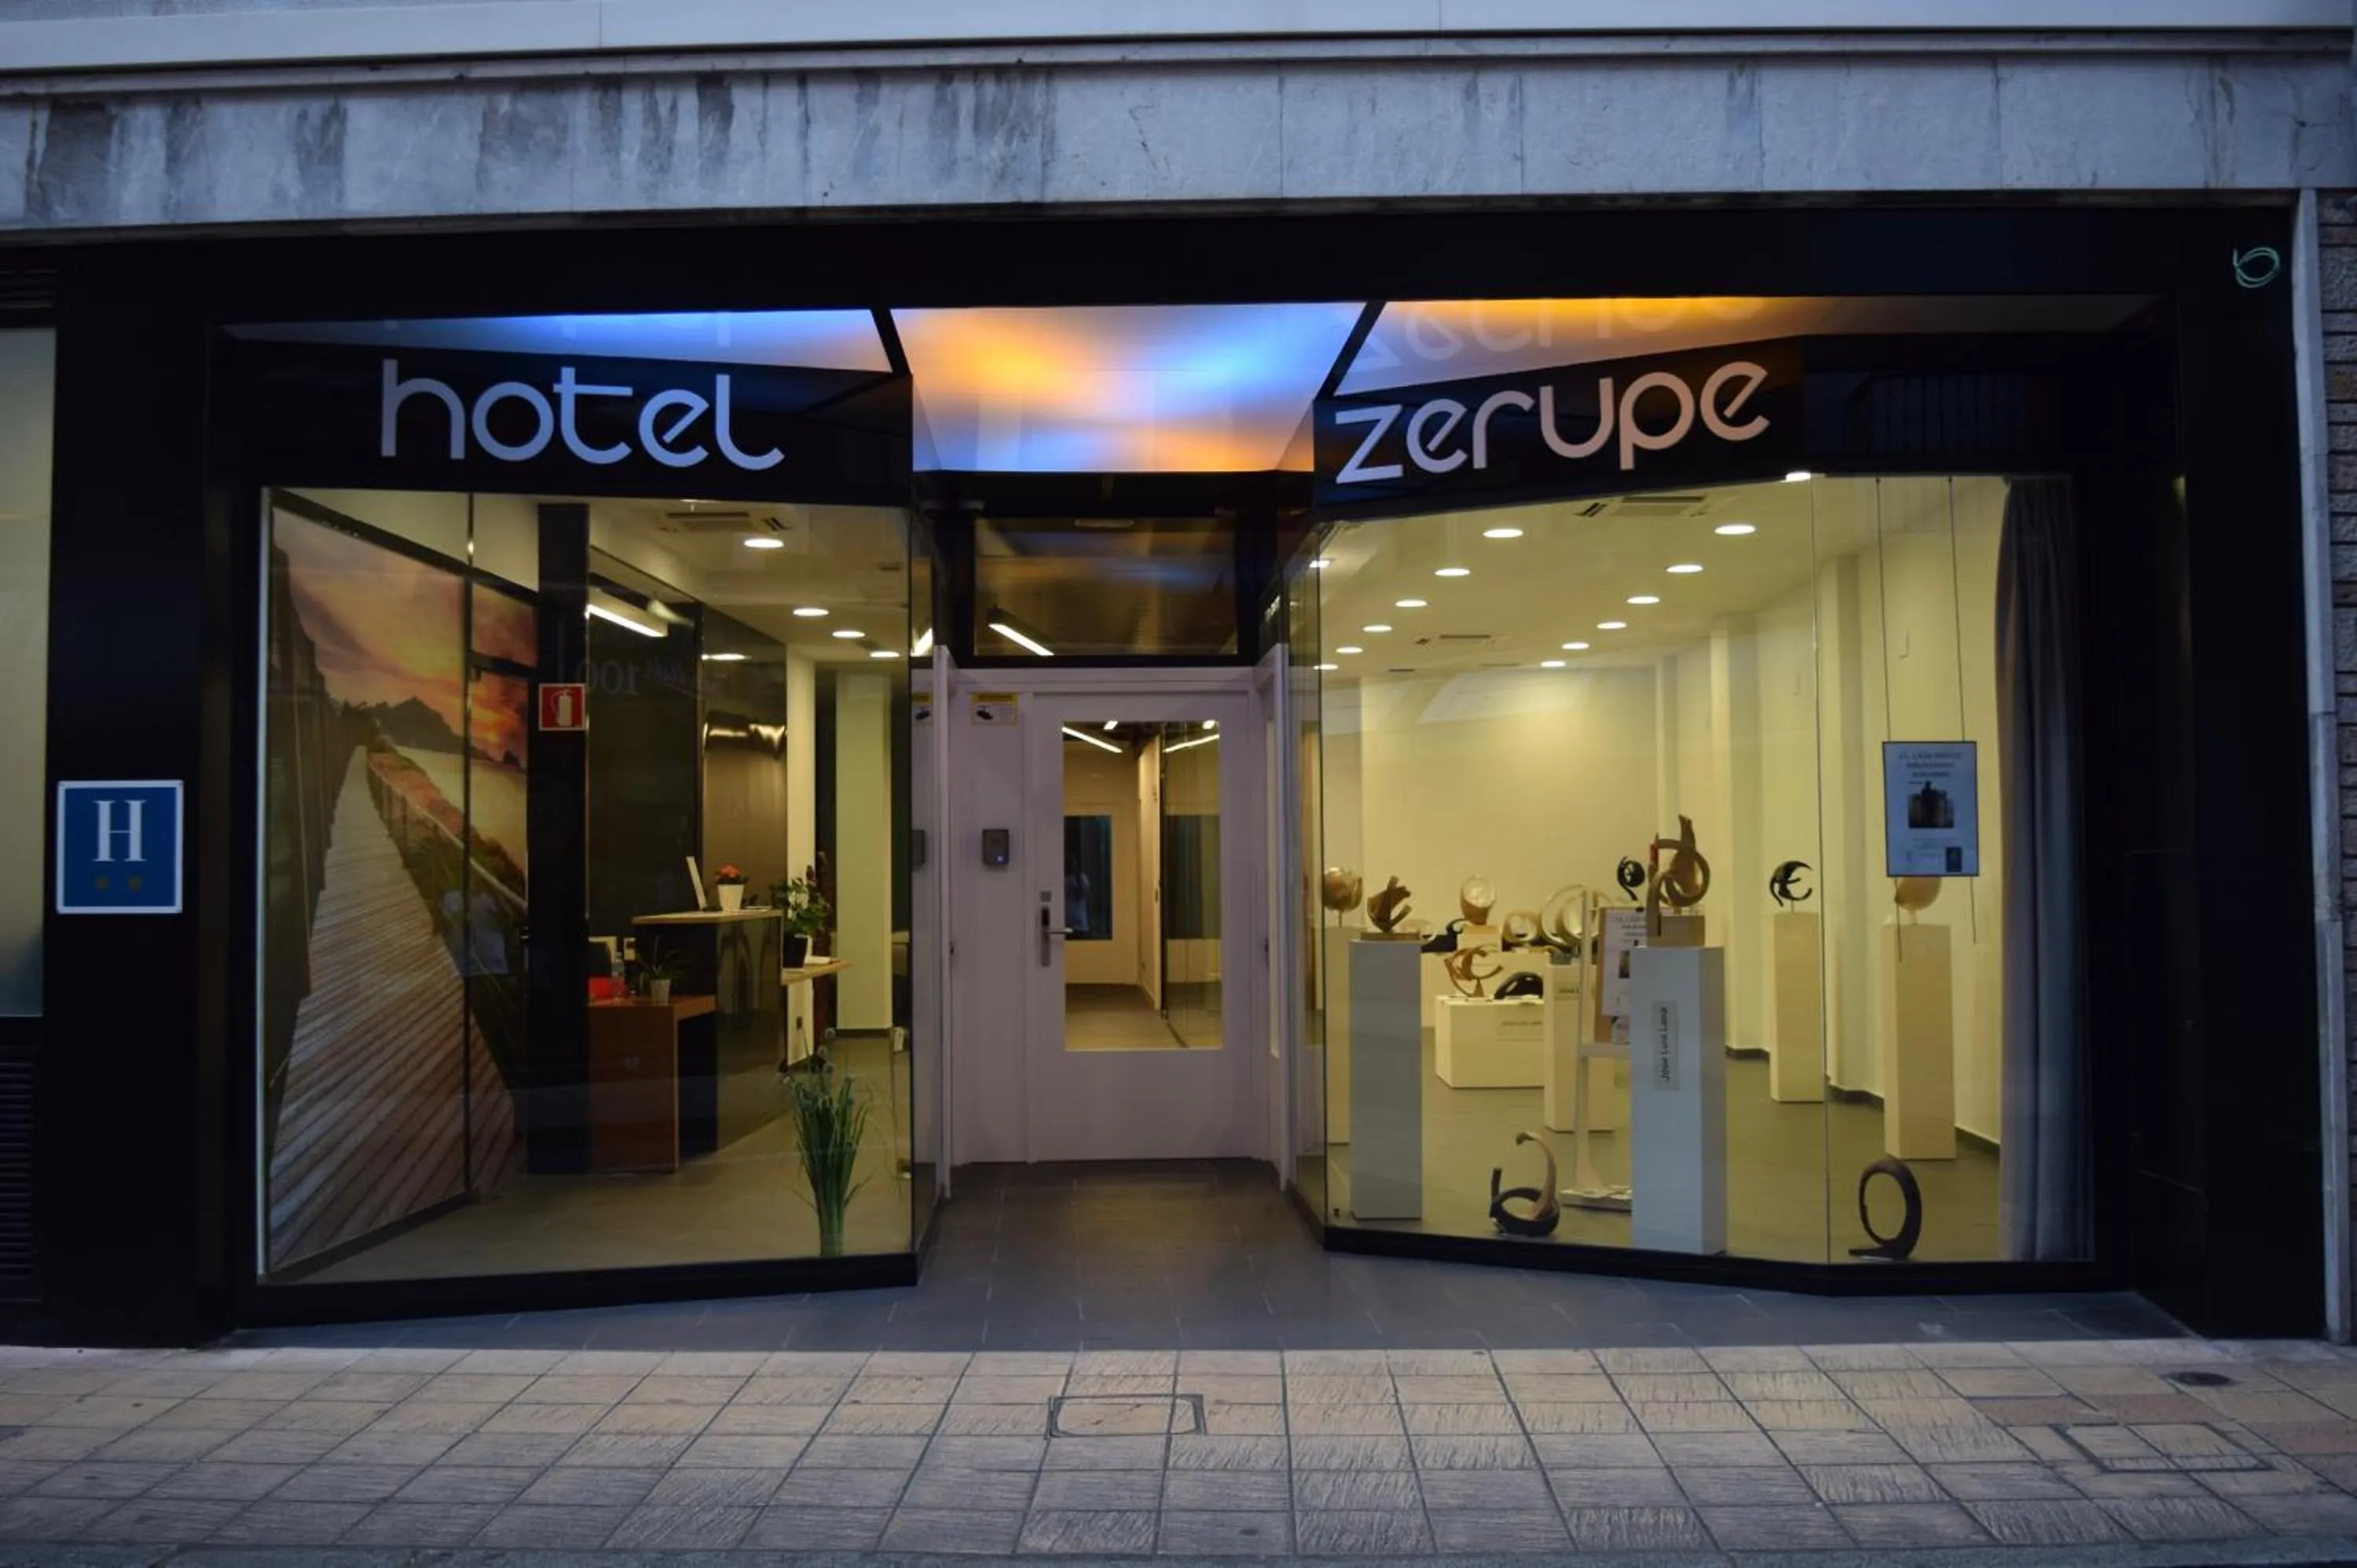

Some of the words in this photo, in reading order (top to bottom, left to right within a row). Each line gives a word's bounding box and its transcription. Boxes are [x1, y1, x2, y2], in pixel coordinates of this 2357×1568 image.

[382, 359, 785, 470] hotel
[1336, 361, 1769, 485] zerupe
[93, 800, 147, 862] H
